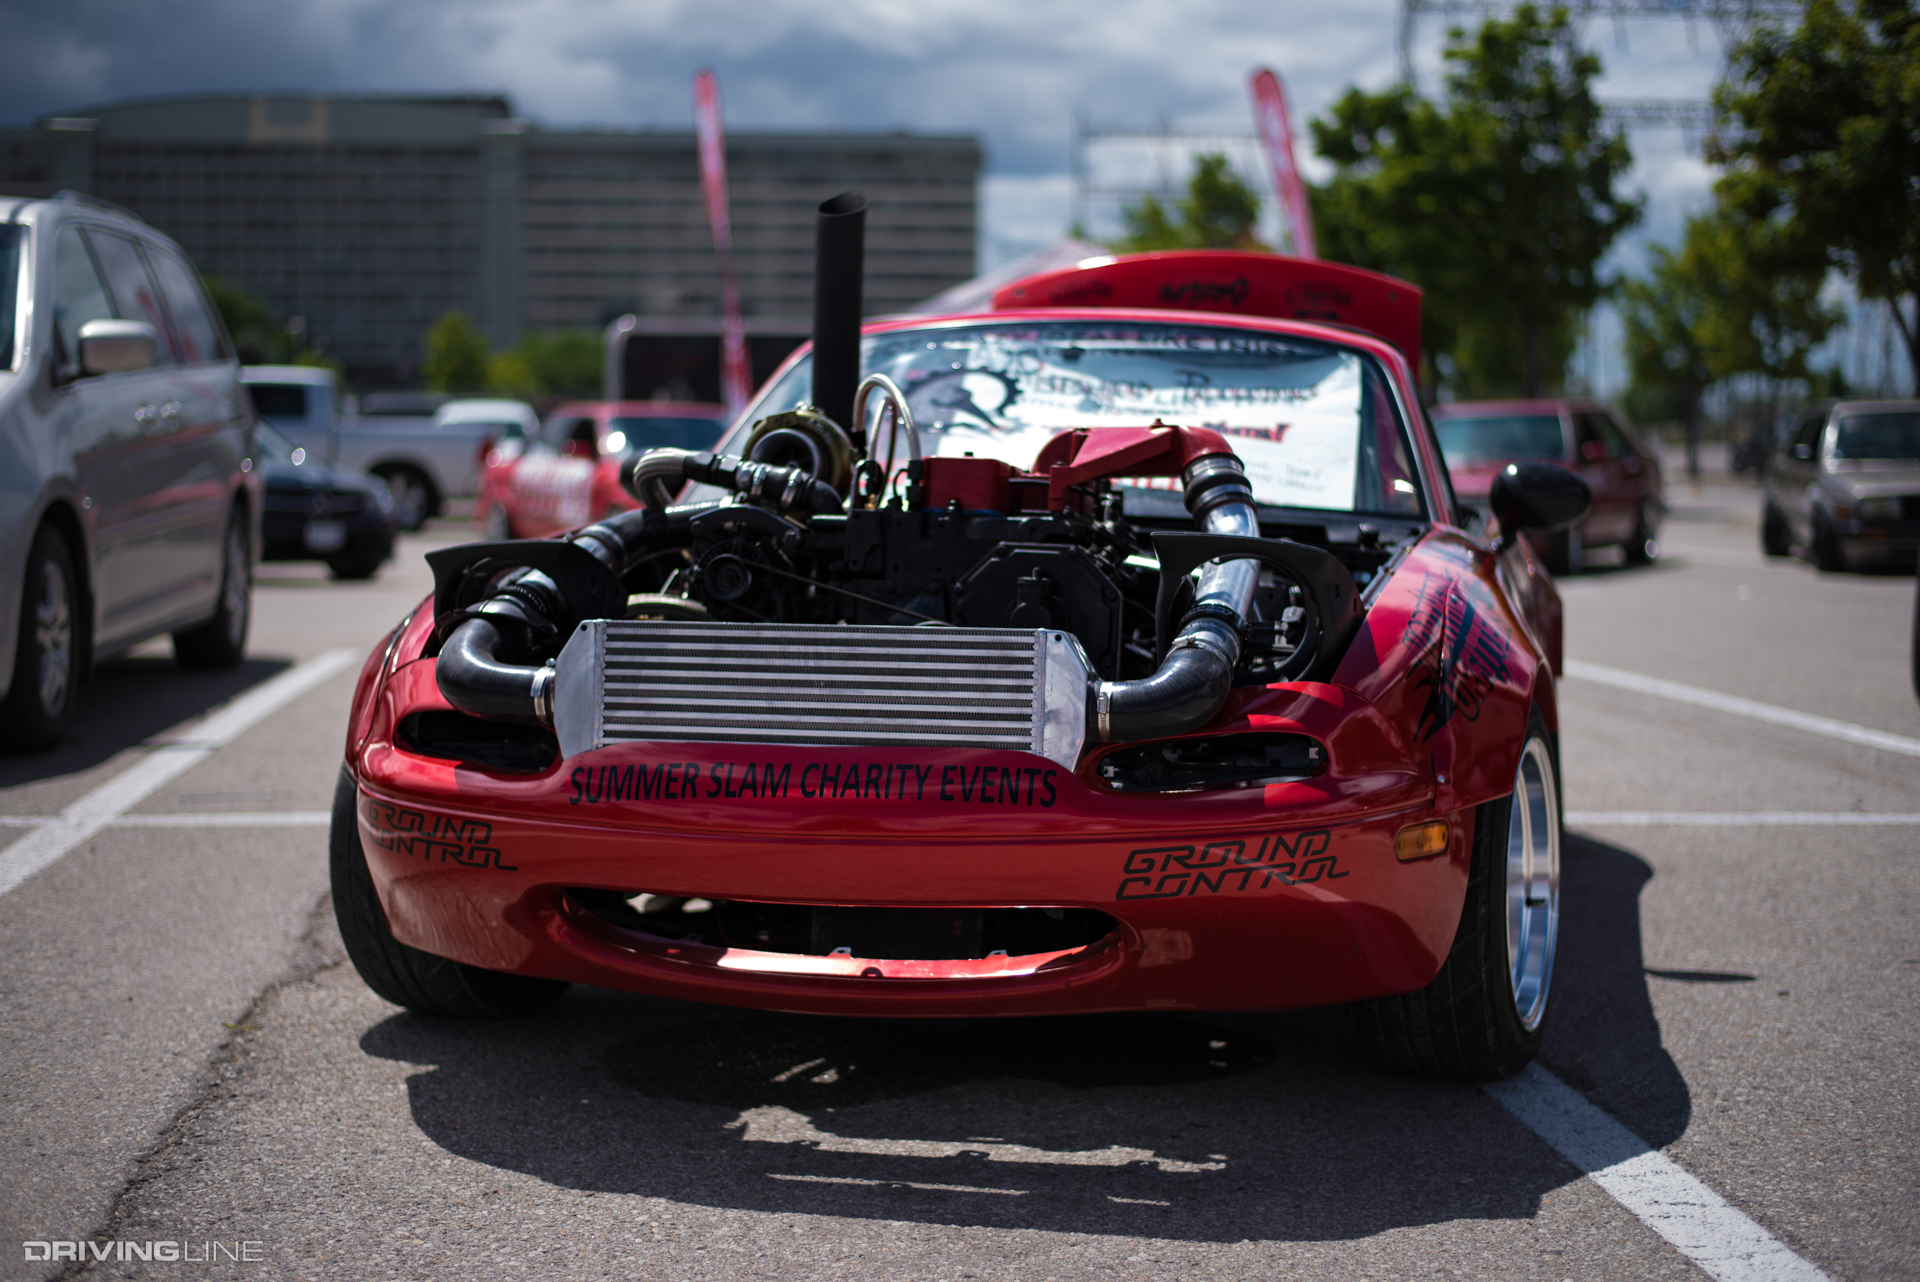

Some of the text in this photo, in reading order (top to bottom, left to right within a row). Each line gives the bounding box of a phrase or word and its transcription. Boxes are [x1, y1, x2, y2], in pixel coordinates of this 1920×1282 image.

[569, 762, 1058, 808] SUMMER SLAM CHARITY EVENTS
[368, 798, 493, 845] GROUND
[368, 821, 518, 871] CONTROL
[1123, 829, 1332, 875] GROUND
[1115, 855, 1350, 901] CONTROL
